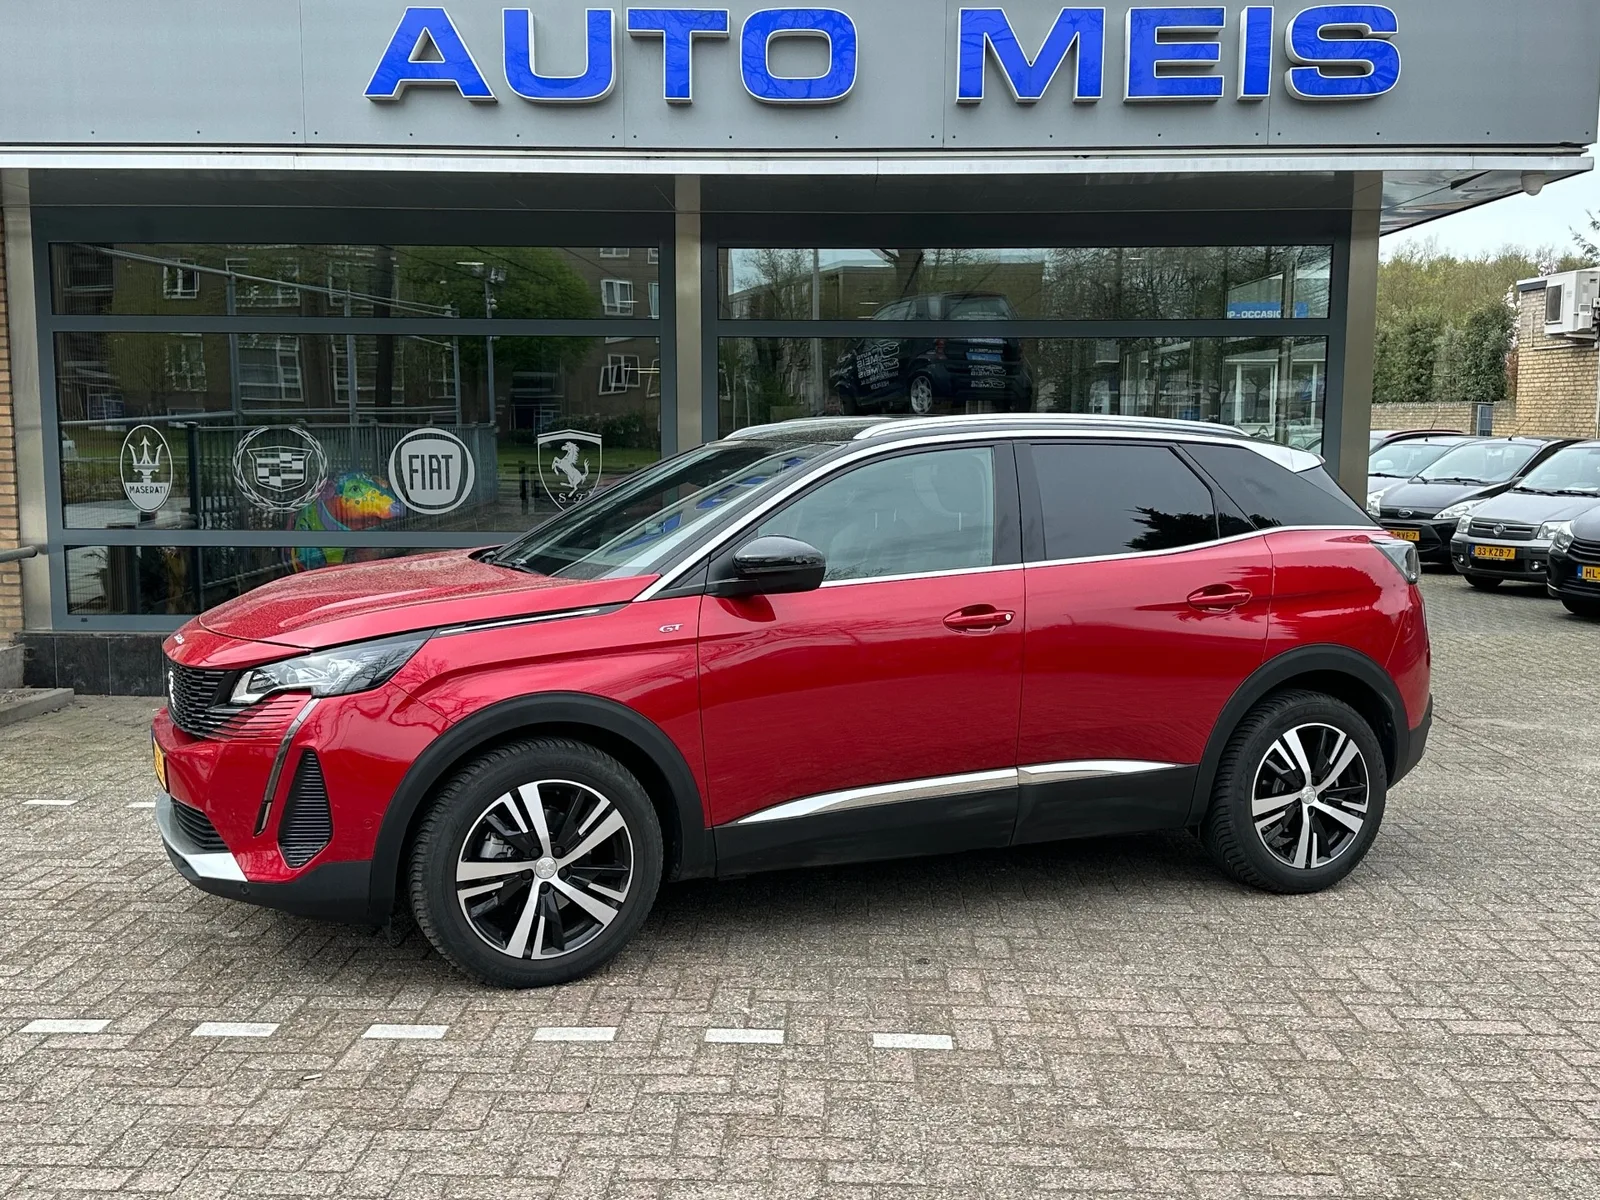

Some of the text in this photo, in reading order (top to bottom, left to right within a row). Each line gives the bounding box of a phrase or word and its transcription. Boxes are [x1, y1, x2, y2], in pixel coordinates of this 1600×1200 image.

[364, 4, 1402, 104] AUTO MEIS
[408, 454, 454, 491] FIAT
[128, 485, 166, 494] MASERATI
[1477, 546, 1512, 558] 33-KZB-7
[659, 623, 684, 633] GT
